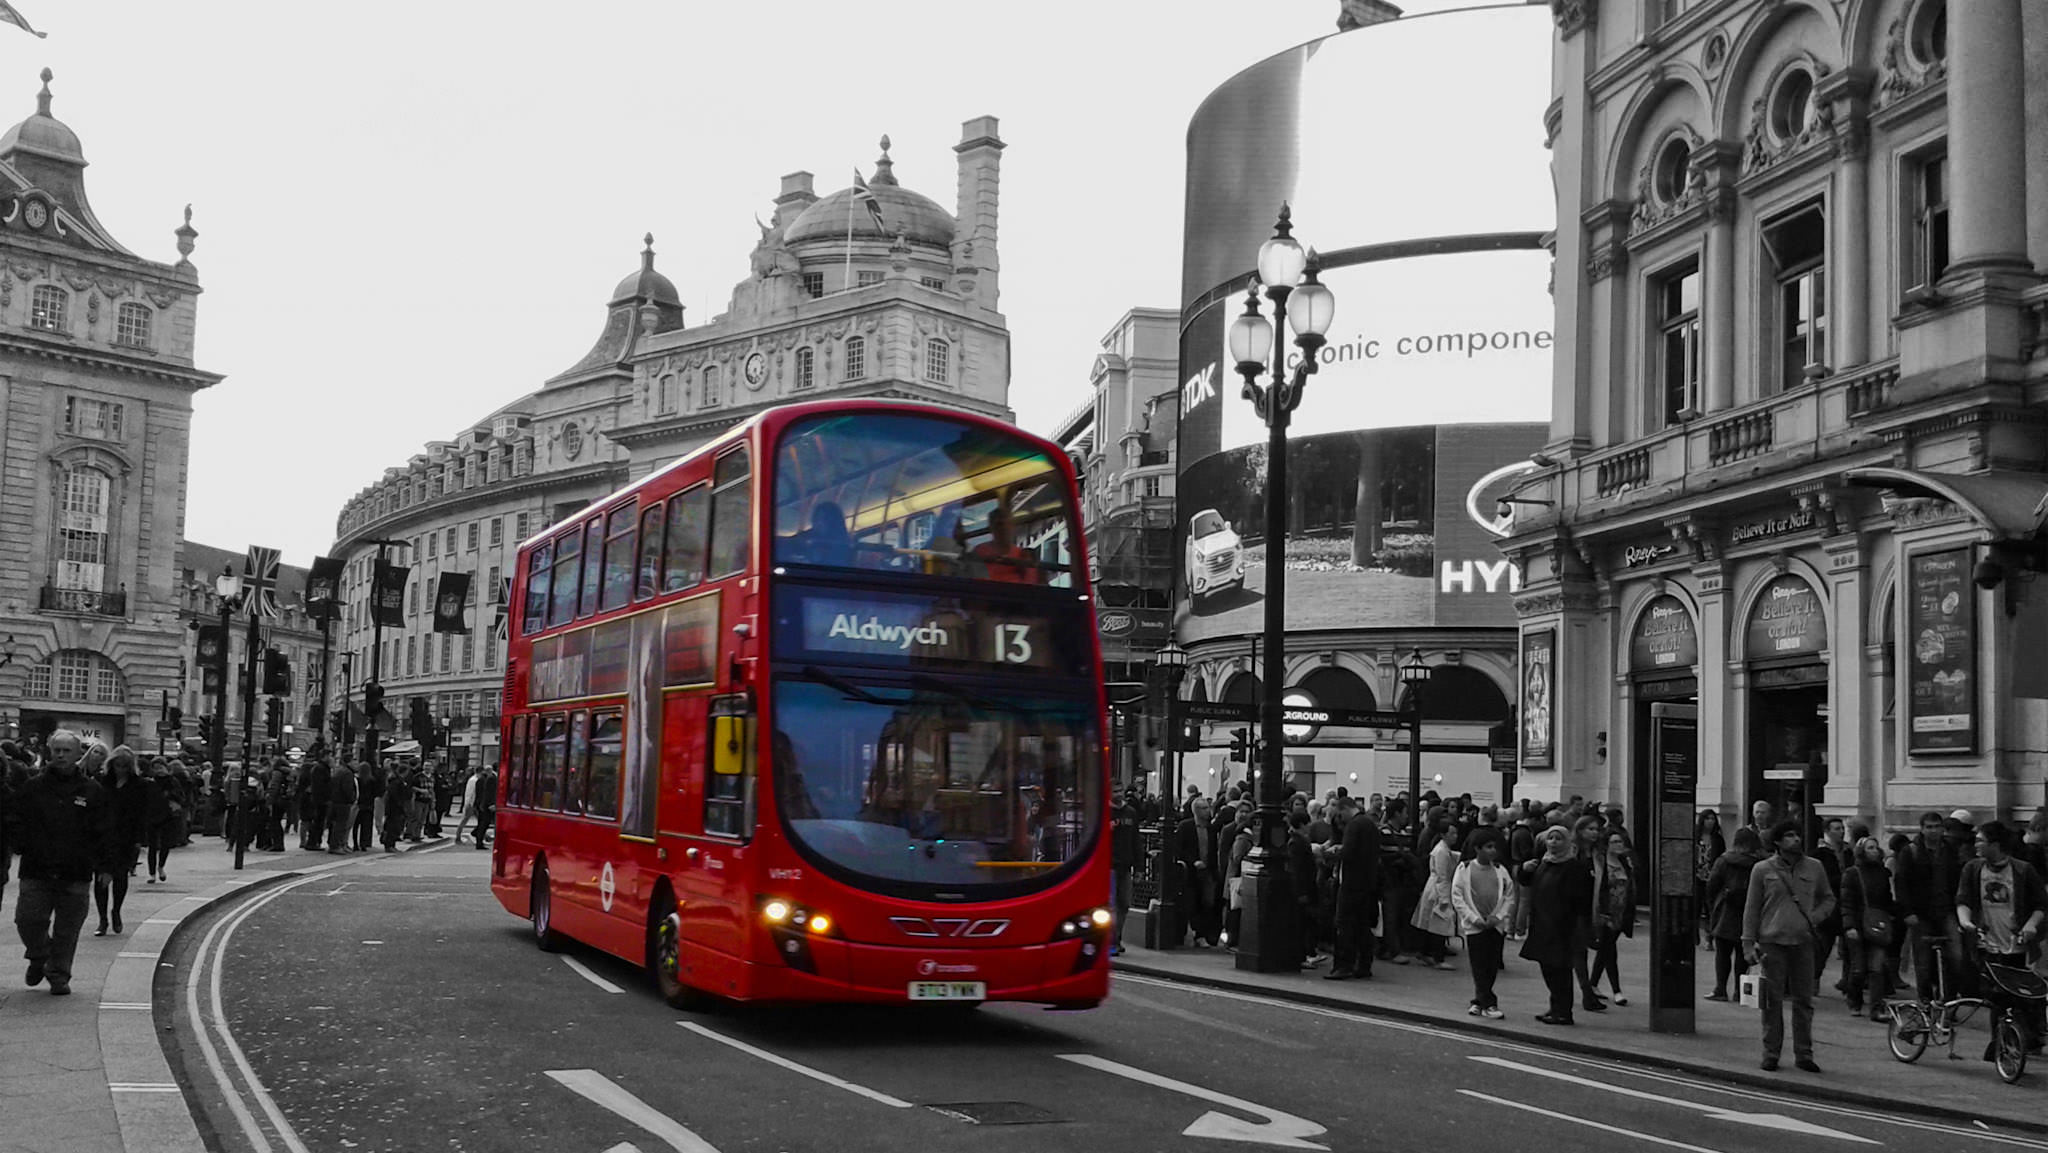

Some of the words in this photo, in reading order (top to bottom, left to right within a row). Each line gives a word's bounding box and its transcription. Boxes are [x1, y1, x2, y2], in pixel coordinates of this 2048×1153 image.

[1185, 362, 1216, 414] TDK
[1732, 524, 1765, 542] Believe
[1766, 519, 1776, 534] It
[1762, 602, 1801, 620] Believe
[829, 614, 948, 649] Aldwych
[994, 624, 1032, 663] 13
